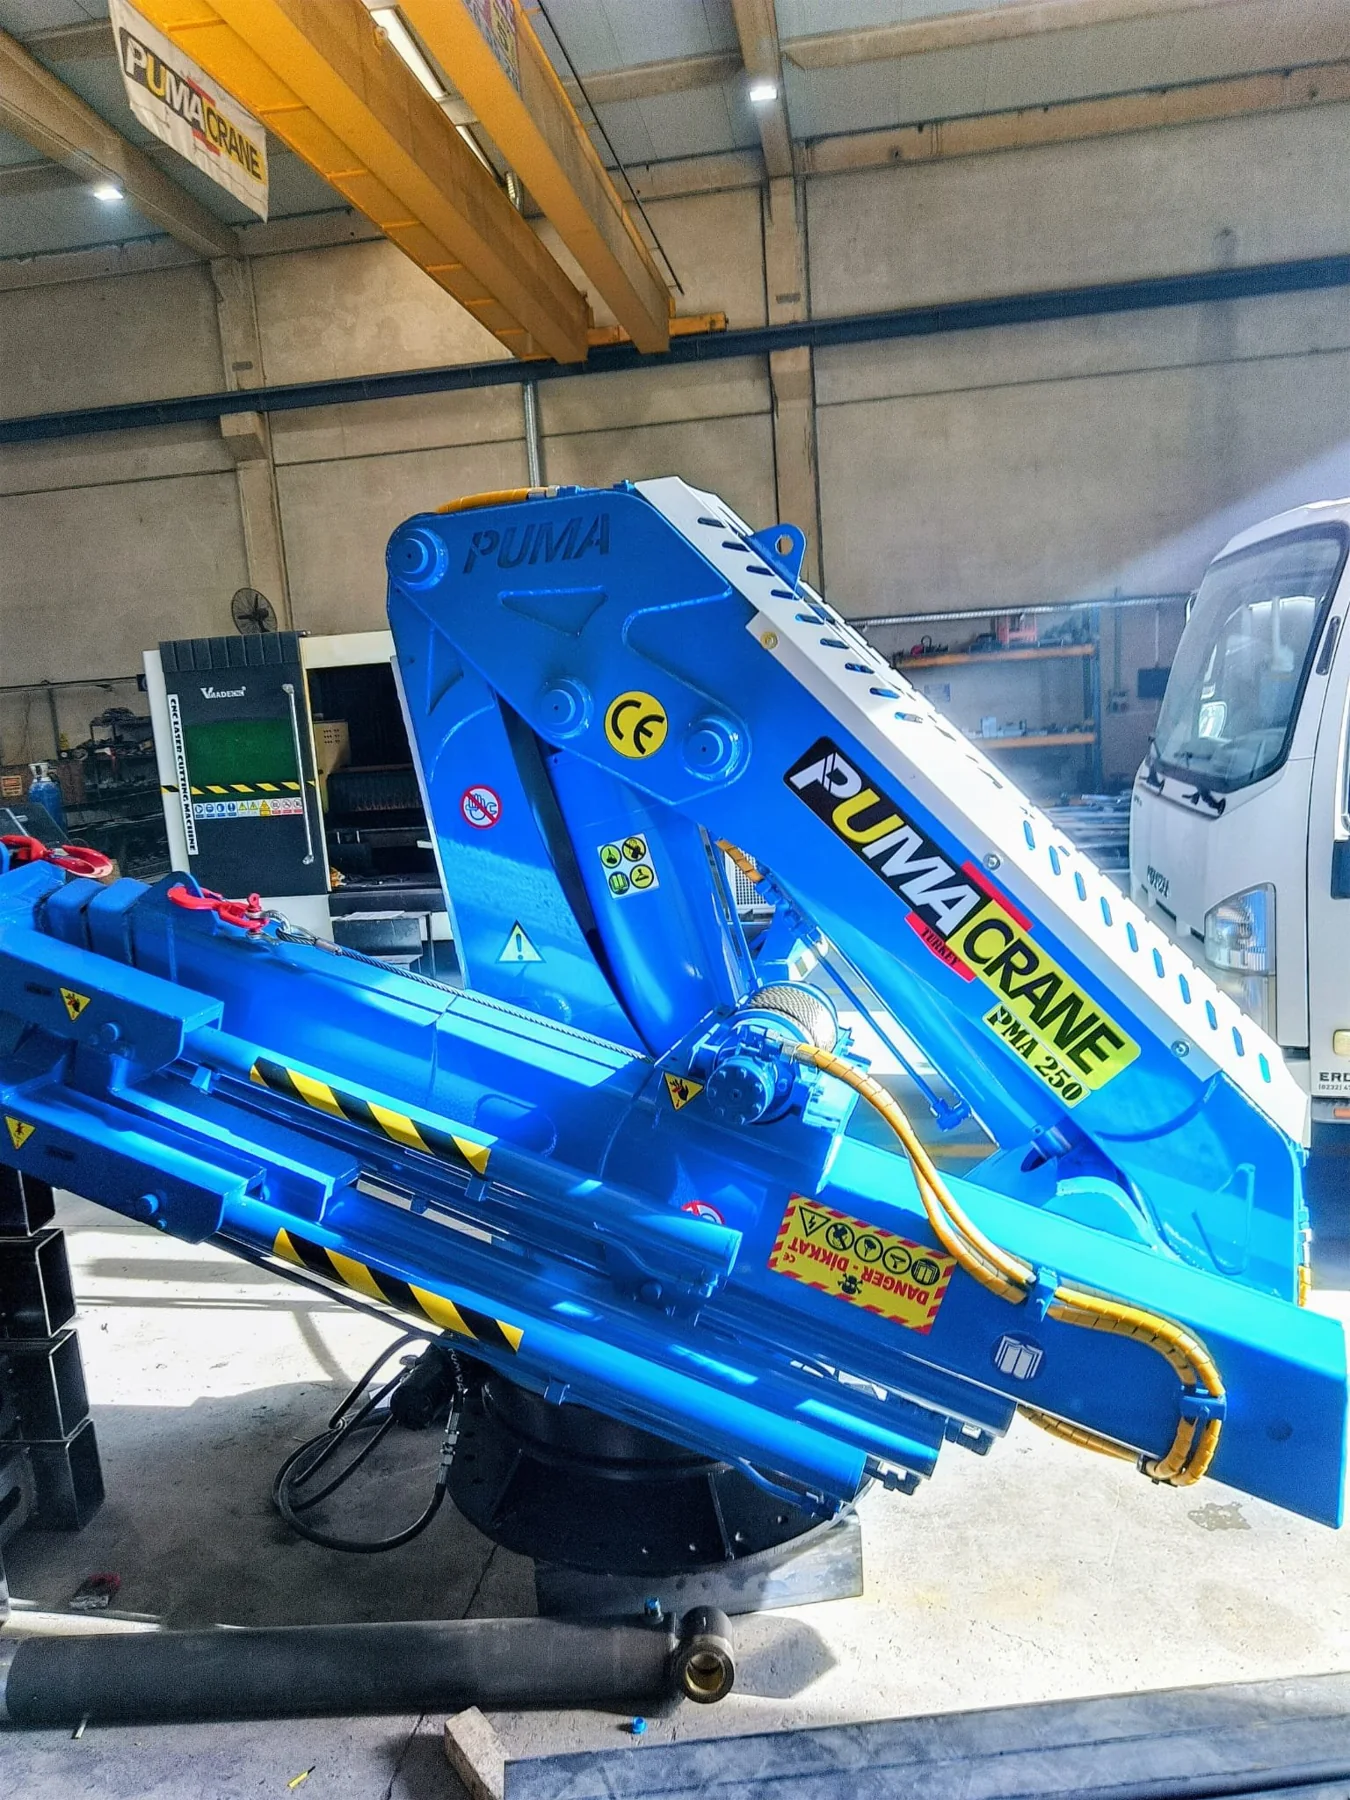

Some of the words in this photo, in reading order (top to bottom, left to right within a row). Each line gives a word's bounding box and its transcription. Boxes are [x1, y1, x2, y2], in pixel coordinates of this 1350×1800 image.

[462, 513, 610, 574] PUMA
[170, 698, 179, 719] CNC
[173, 721, 183, 753] LASER
[177, 755, 189, 802] CUTTING
[183, 804, 196, 851] MACHINE
[789, 752, 981, 936] PUMA
[962, 918, 1126, 1076] CRANE
[921, 927, 958, 965] TURKEY
[987, 1005, 1039, 1060] PMA
[1034, 1055, 1083, 1101] 250
[787, 1236, 850, 1271] DİKKAT
[861, 1265, 930, 1306] DANGER
